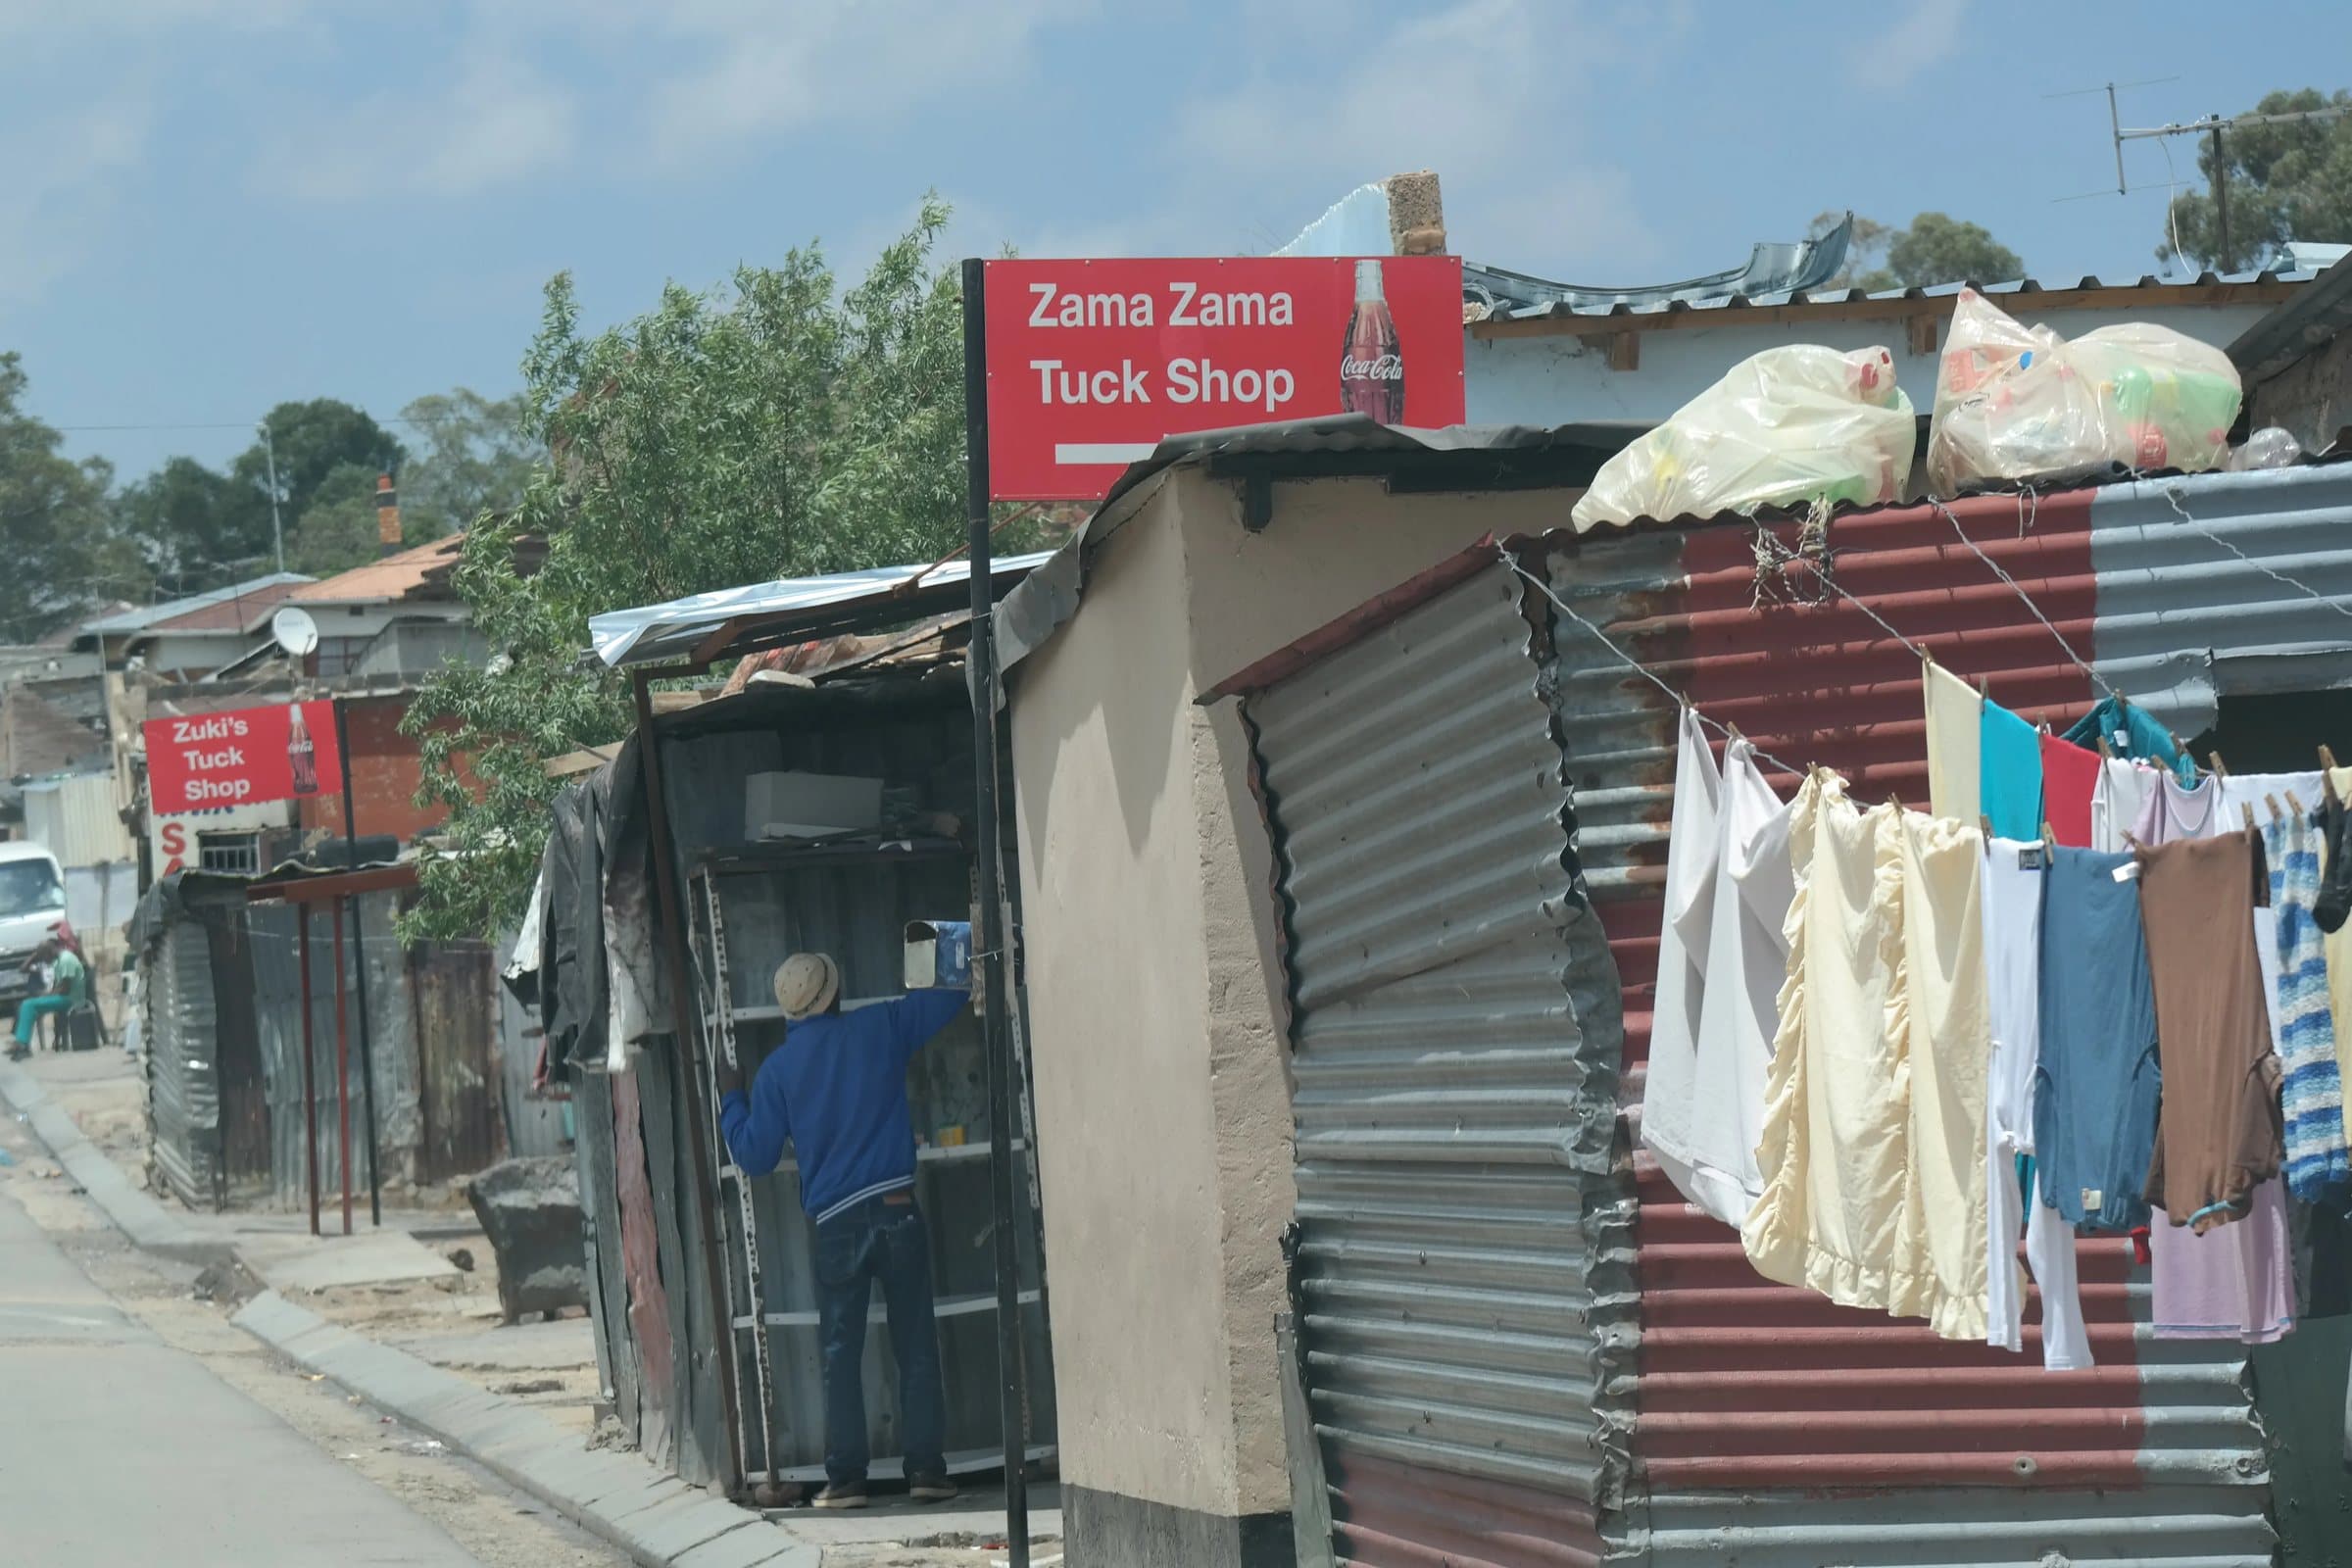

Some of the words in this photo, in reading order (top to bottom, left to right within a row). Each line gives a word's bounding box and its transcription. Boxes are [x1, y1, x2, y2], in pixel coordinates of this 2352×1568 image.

[1028, 282, 1154, 328] Zama
[1168, 281, 1294, 327] Zama
[1029, 359, 1152, 405] Tuck
[1165, 358, 1296, 413] Shop
[172, 716, 249, 744] Zuki's
[183, 746, 245, 771] Tuck
[184, 778, 251, 801] Shop
